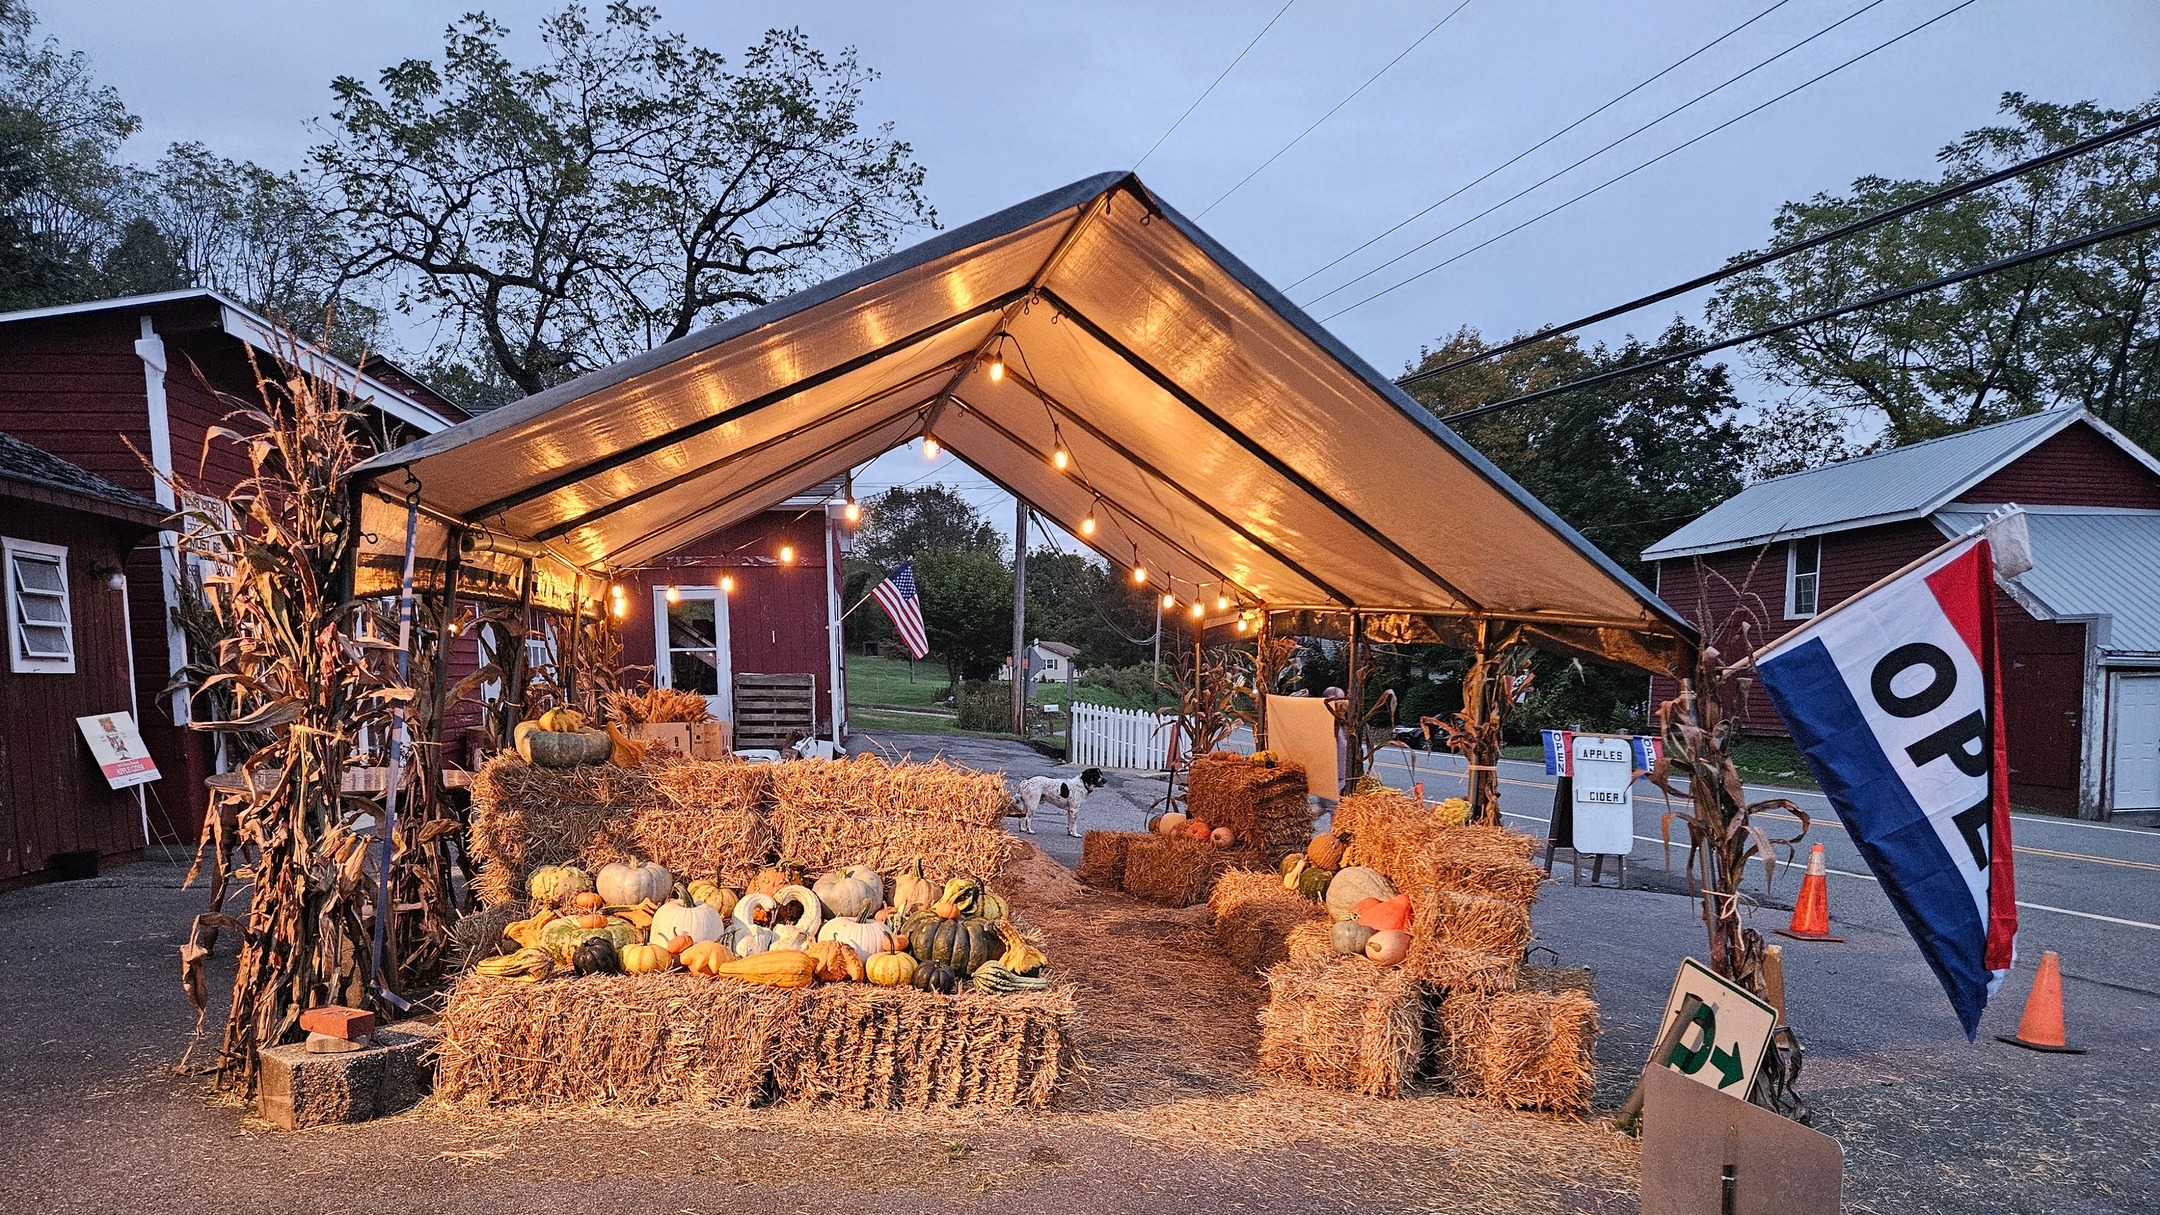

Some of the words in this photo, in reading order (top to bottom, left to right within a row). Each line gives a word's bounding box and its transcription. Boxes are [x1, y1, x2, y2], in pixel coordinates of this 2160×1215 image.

[213, 541, 222, 553] BE
[1553, 732, 1565, 773] OPEN
[1583, 749, 1623, 761] APPLES
[117, 767, 131, 775] APPLE
[1589, 791, 1619, 802] CIDER
